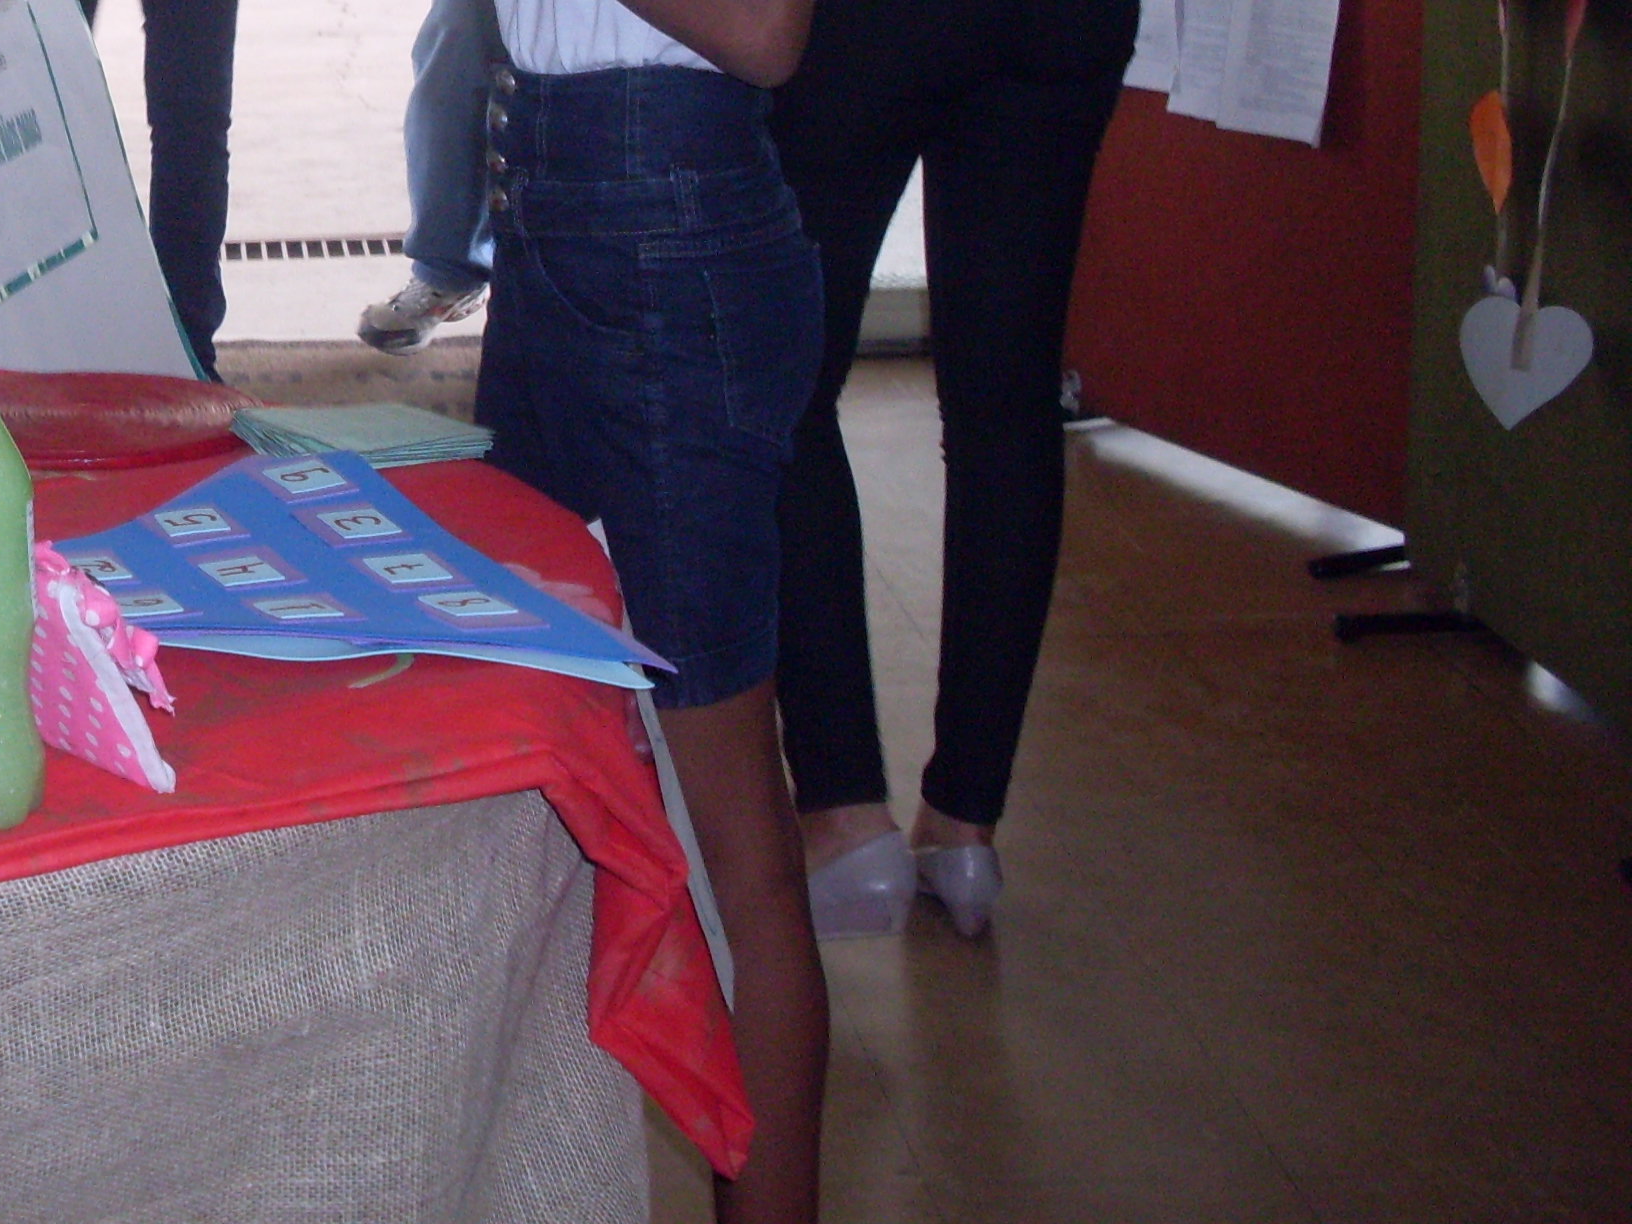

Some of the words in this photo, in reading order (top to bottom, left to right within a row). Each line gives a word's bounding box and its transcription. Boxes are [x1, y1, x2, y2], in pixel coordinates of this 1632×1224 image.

[164, 513, 218, 527] 5
[334, 515, 382, 531] 3
[216, 562, 265, 577] 4
